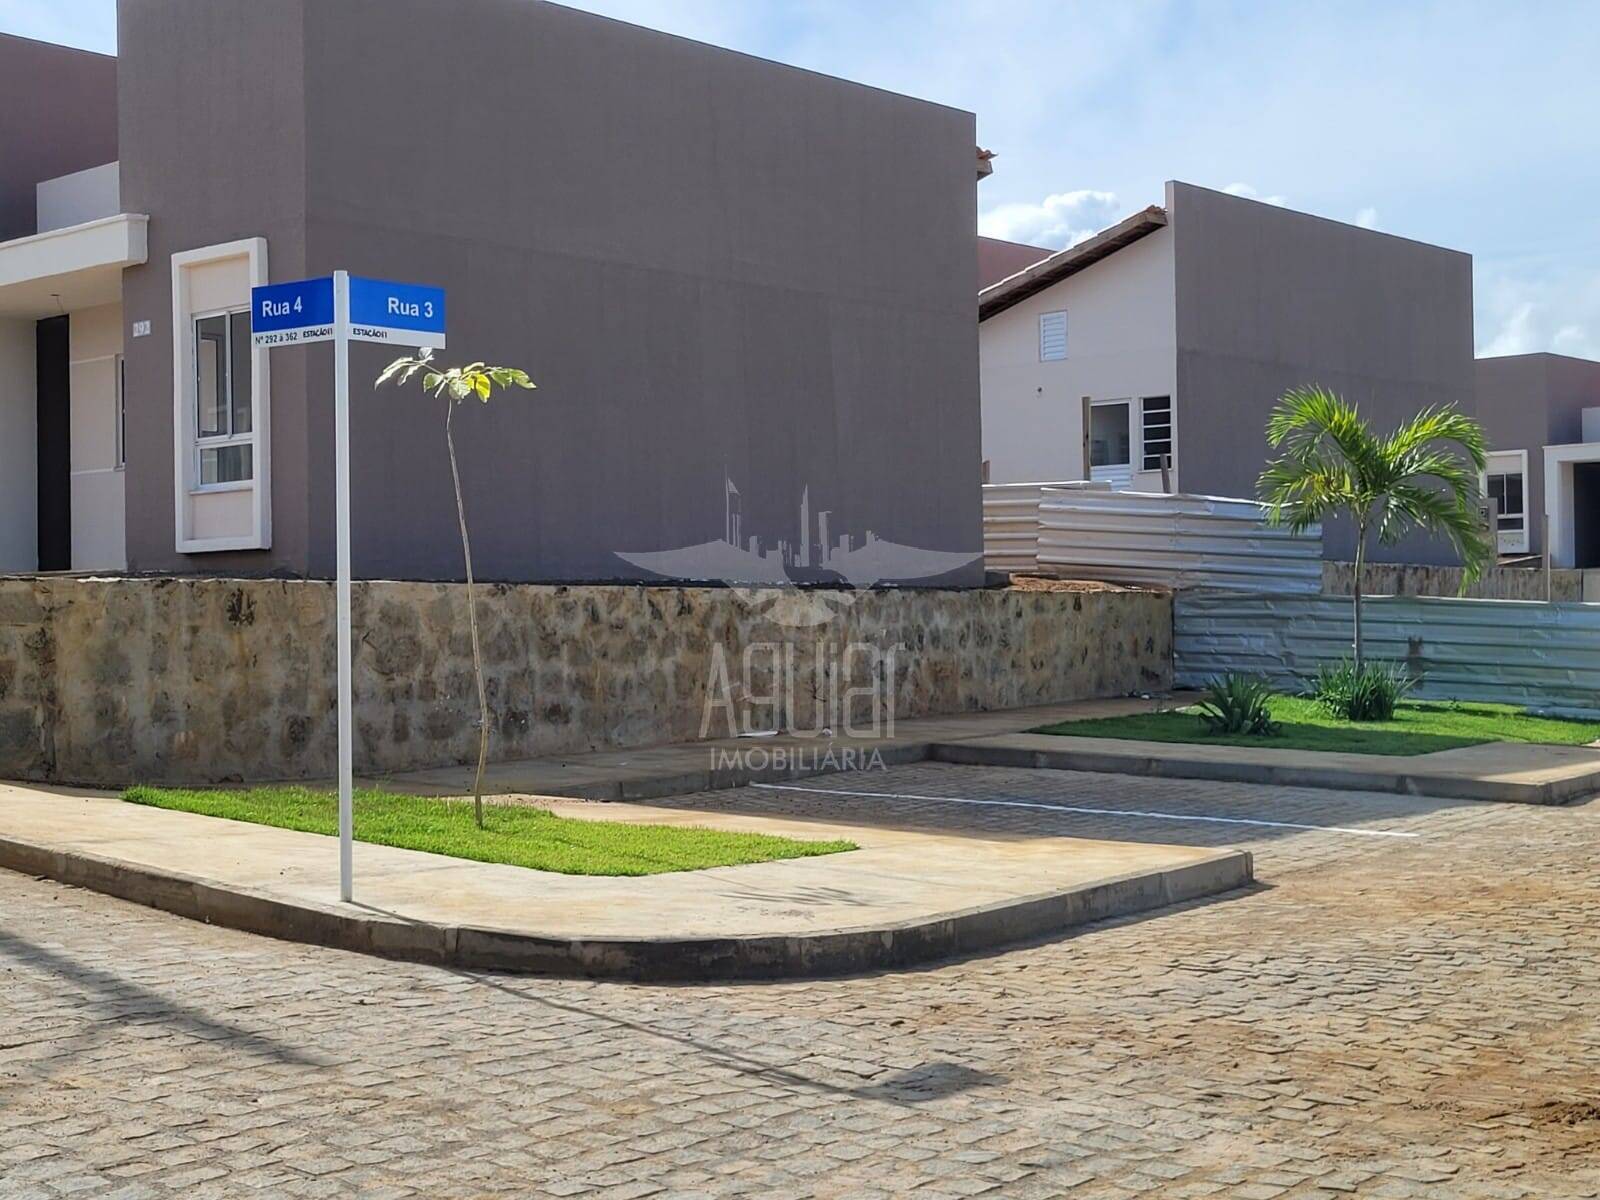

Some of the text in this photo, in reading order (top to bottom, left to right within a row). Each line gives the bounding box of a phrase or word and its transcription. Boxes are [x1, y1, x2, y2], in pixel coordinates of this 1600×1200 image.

[262, 295, 303, 318] Rua 4
[387, 296, 434, 318] Rua 3
[265, 334, 278, 344] 292
[286, 332, 298, 342] 362
